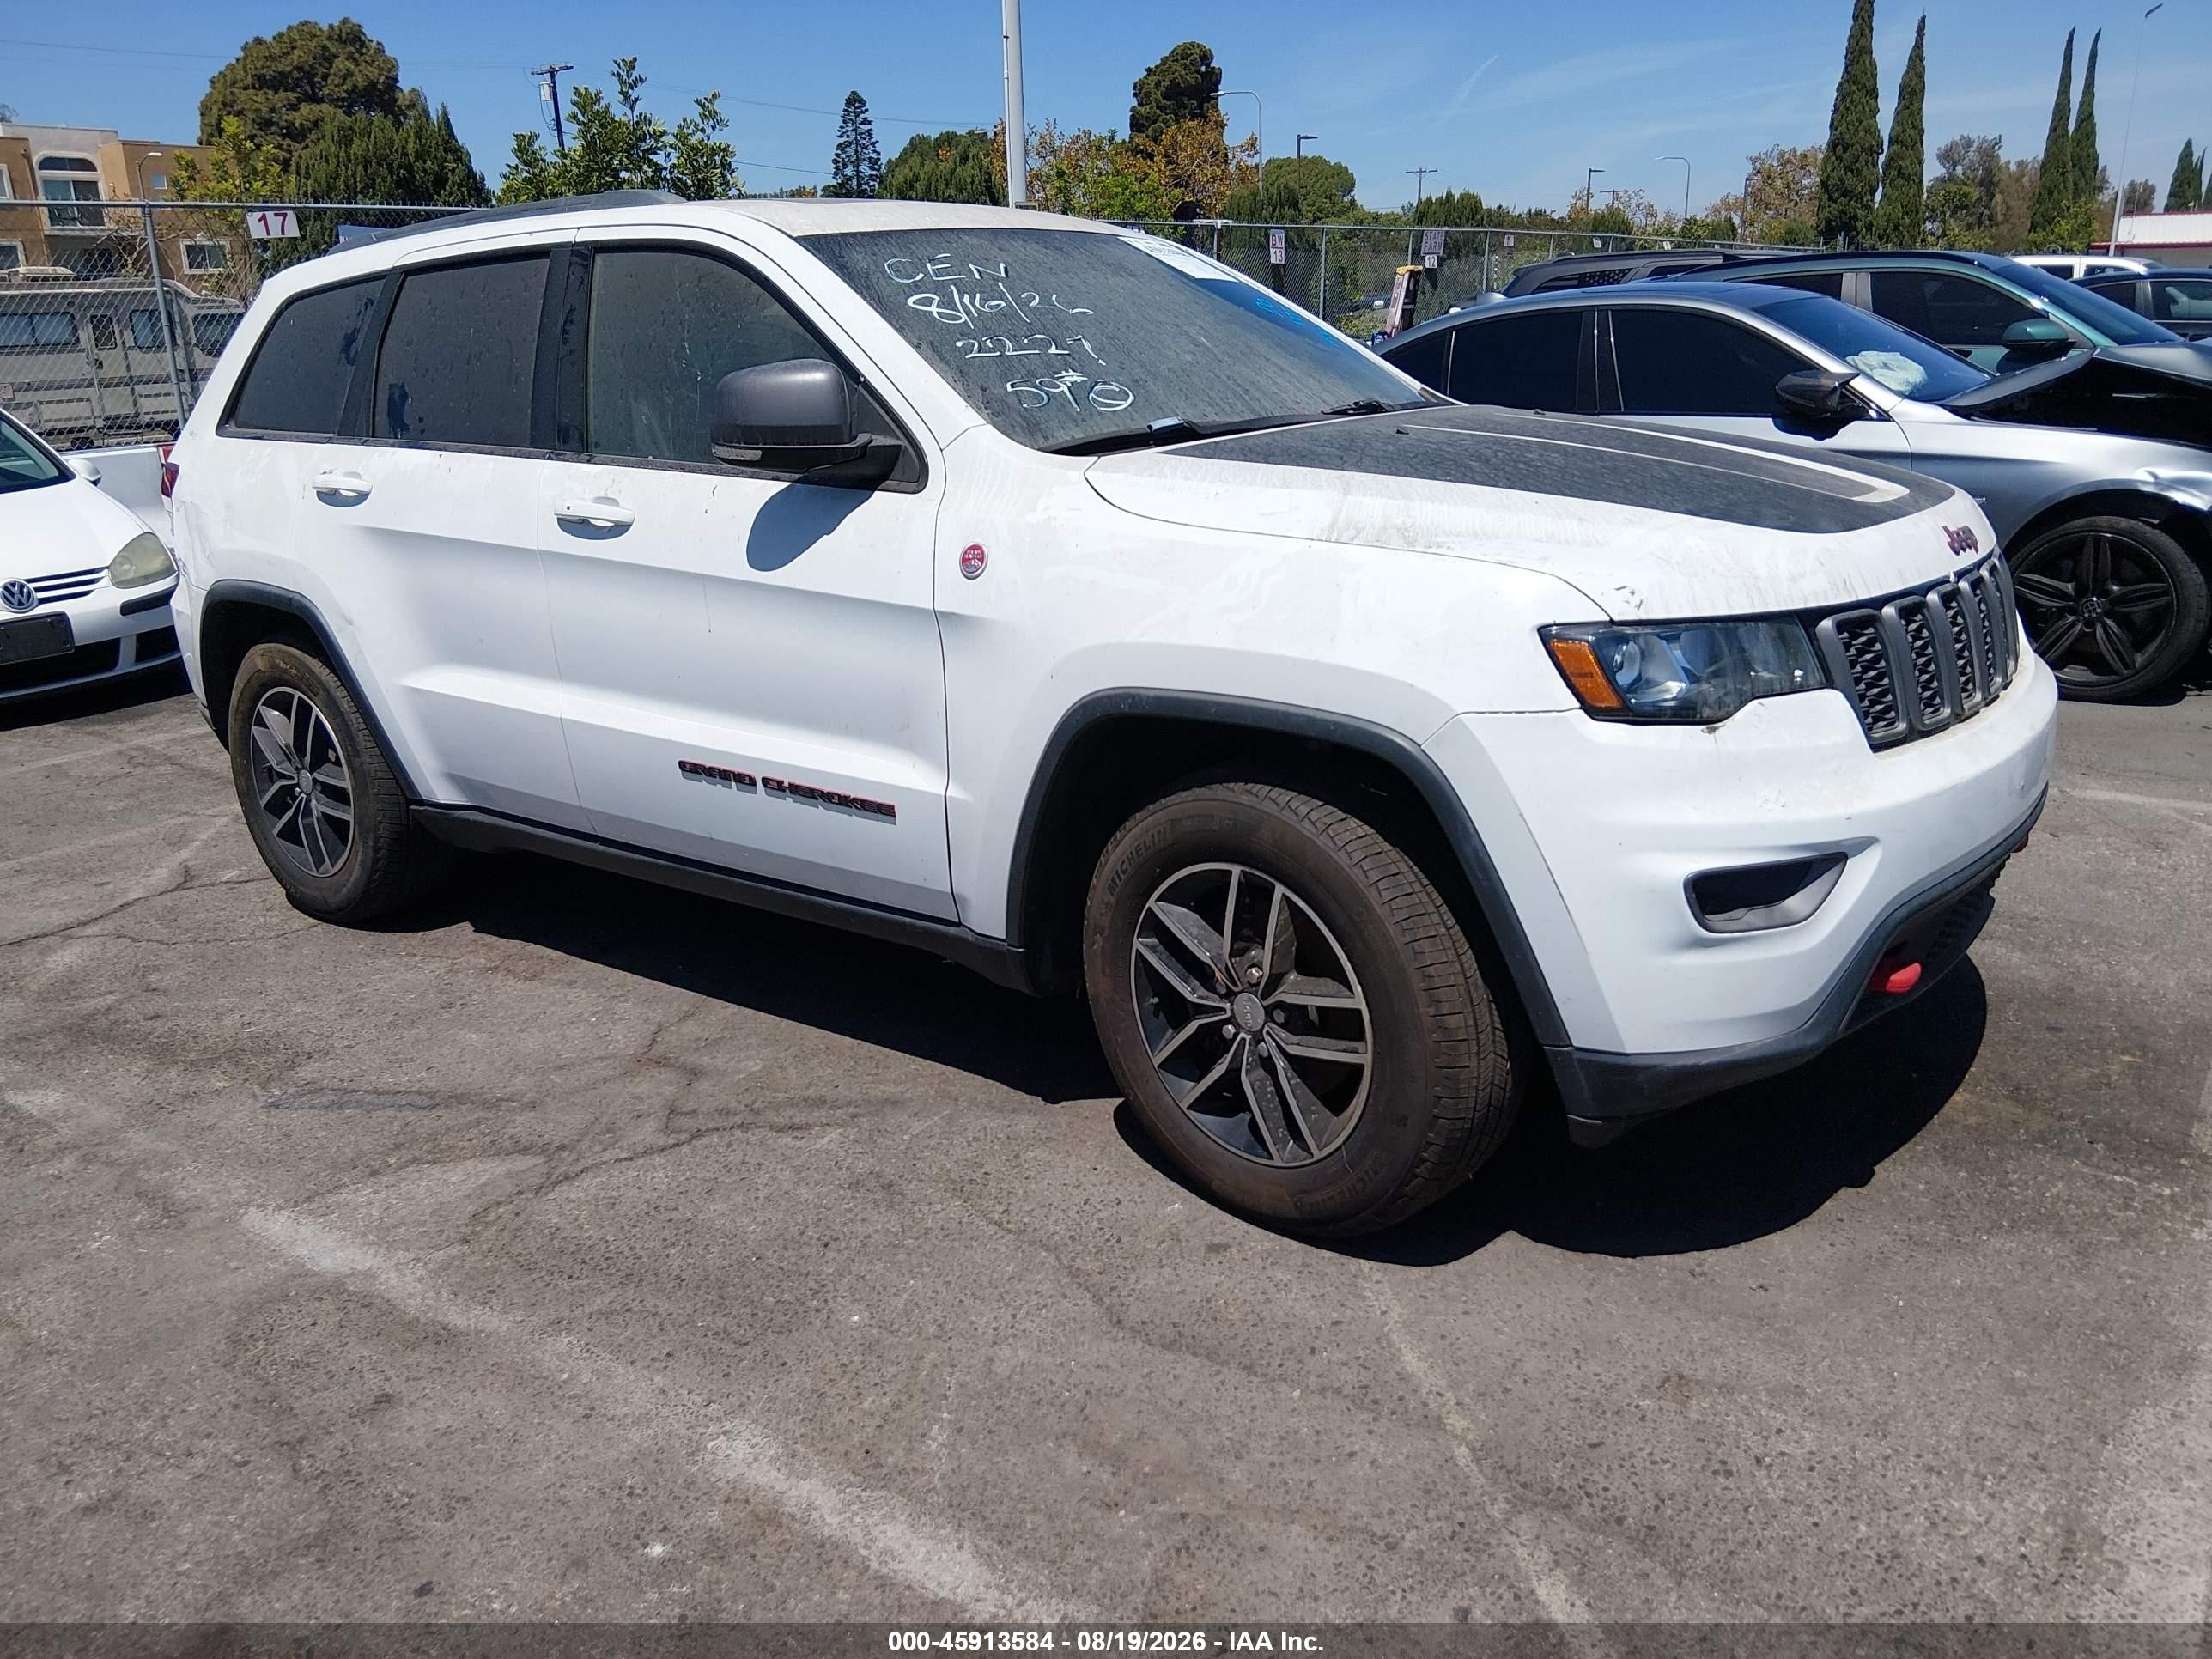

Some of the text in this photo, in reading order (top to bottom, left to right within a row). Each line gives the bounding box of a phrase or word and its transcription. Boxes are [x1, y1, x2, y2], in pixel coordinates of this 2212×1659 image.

[257, 212, 288, 237] 17
[1271, 234, 1284, 246] BW
[1425, 231, 1444, 241] STATE
[1424, 241, 1443, 252] FARM
[1273, 251, 1284, 263] 13
[1427, 256, 1437, 268] 12
[884, 253, 1008, 283] CEN
[678, 759, 757, 787] GRAND
[761, 776, 897, 817] CHEROKEE
[1106, 827, 1169, 898] MICHELIN
